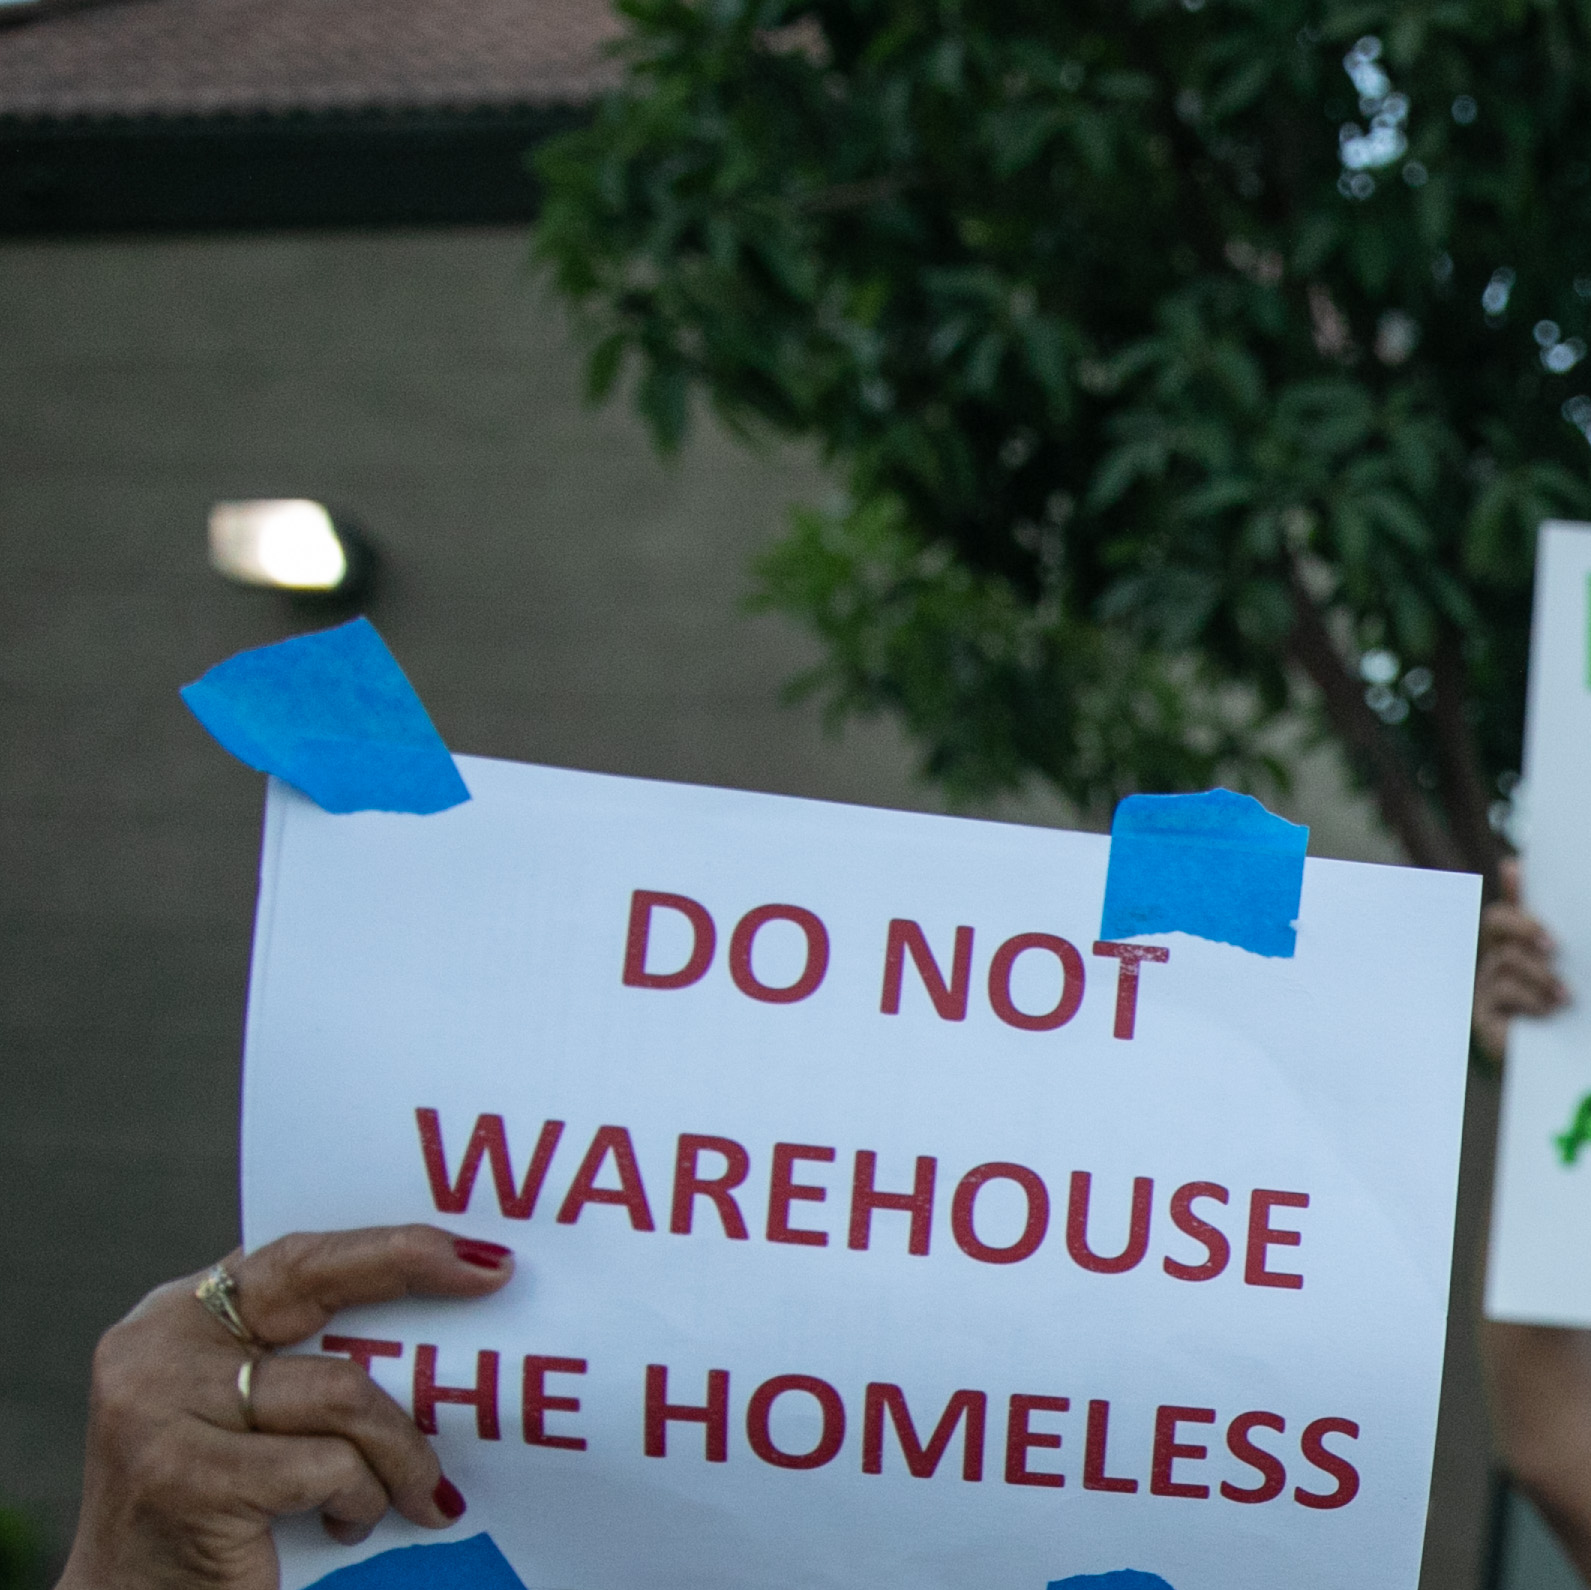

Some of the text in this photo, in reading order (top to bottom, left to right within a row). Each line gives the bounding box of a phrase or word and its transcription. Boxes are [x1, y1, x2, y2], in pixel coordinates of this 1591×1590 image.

[622, 889, 1170, 1041] DO NOT
[415, 1107, 1311, 1291] WAREHOUSE
[644, 1364, 1361, 1511] HOMELESS
